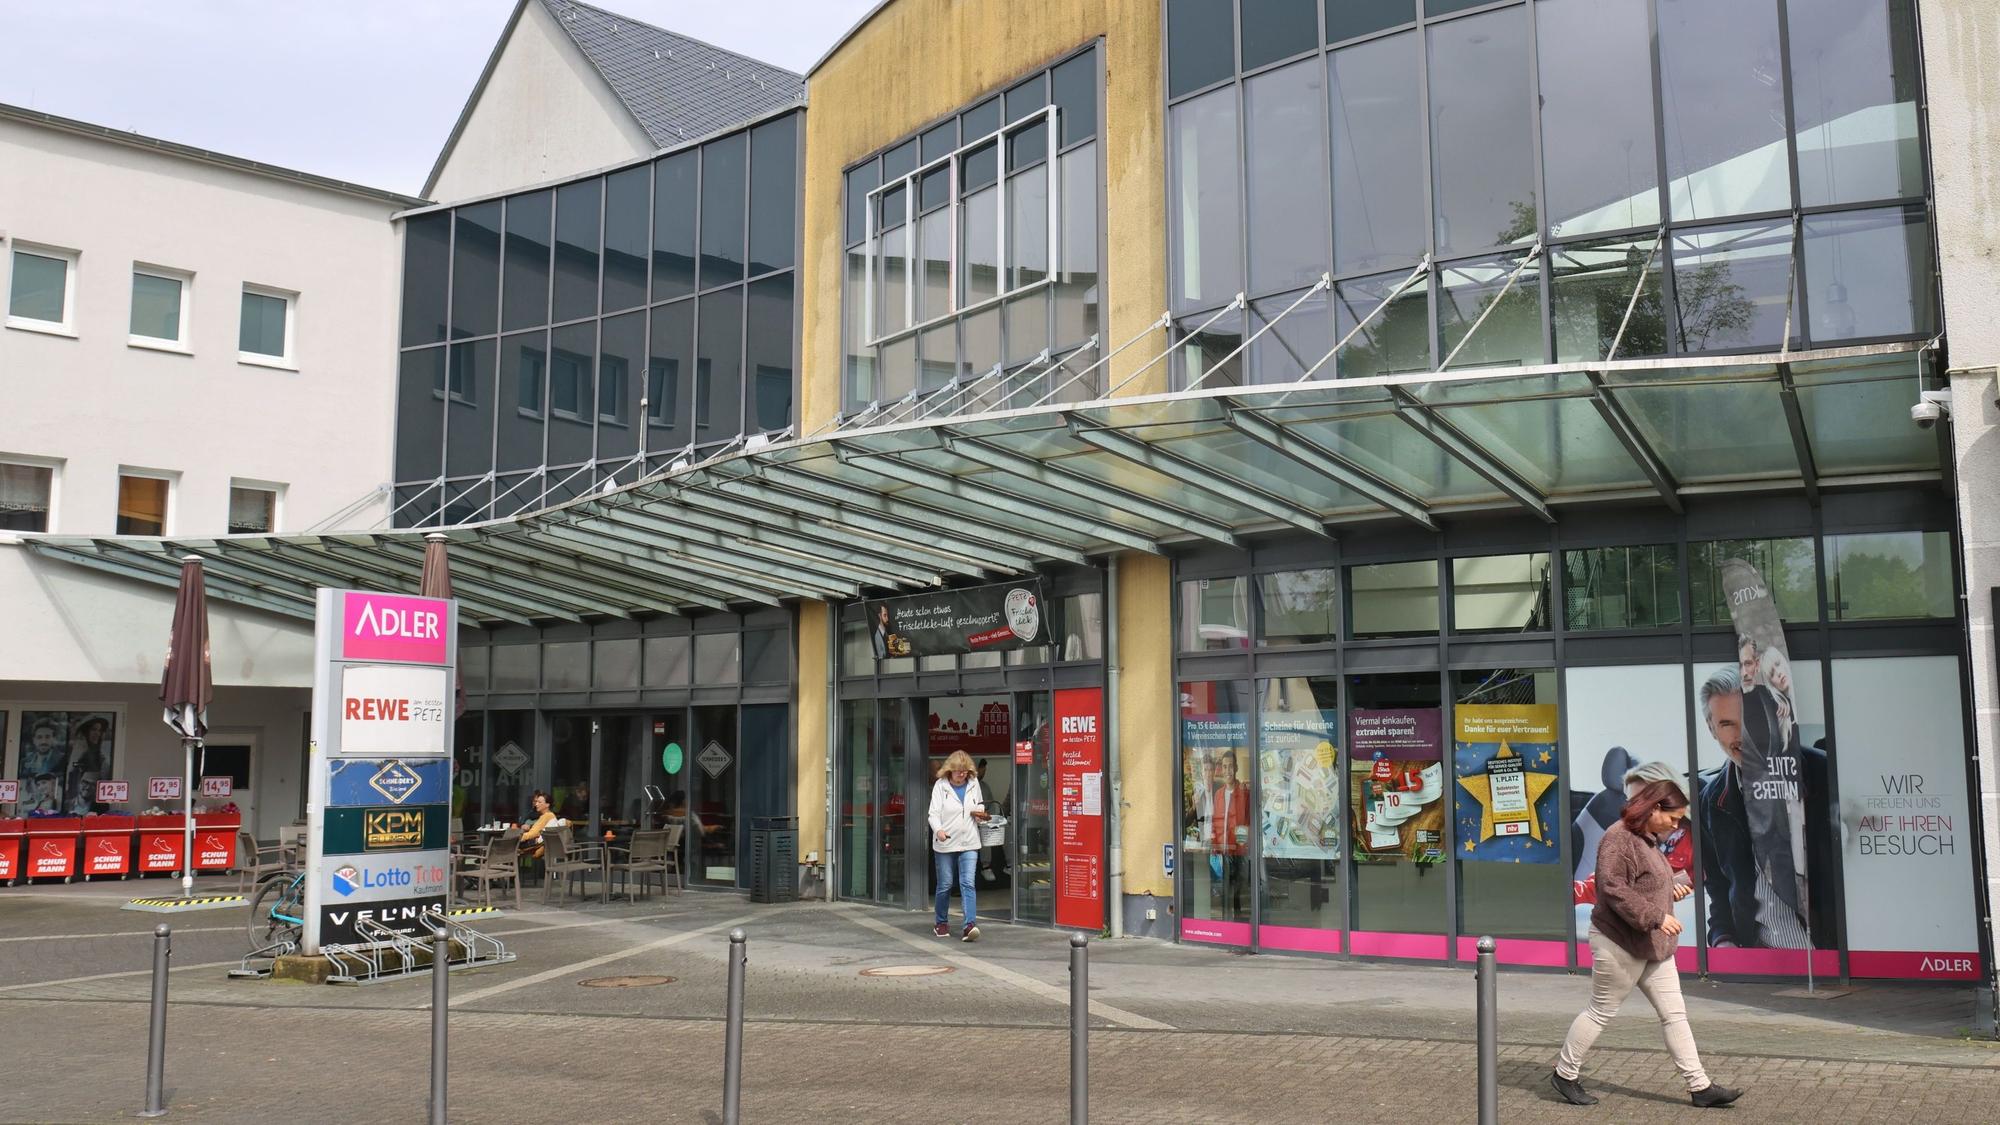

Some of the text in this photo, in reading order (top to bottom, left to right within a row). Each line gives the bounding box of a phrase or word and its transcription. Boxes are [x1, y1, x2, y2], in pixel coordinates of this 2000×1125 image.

[933, 604, 951, 615] etwas
[354, 600, 440, 640] ADLER
[345, 697, 410, 721] REWE
[413, 706, 443, 722] PETZ
[1062, 715, 1096, 733] REWE
[1187, 721, 1196, 730] Pro
[1198, 721, 1204, 730] 15
[1209, 721, 1246, 730] Einkaufswert
[1264, 719, 1334, 731] Scheine für Vereine
[1355, 715, 1416, 726] Viermal einkaufen,
[1355, 726, 1415, 737] extraviel sparen!
[1464, 725, 1549, 734] Danke für euer Vertrauen!
[1264, 734, 1274, 744] ist
[1397, 767, 1424, 792] 15
[1881, 774, 1924, 794] WIR
[100, 784, 126, 799] 12,95
[152, 780, 178, 795] 12,95
[204, 780, 229, 794] 14,95
[1387, 794, 1400, 807] 10
[1867, 797, 1941, 809] FREUEN UNS
[1377, 803, 1384, 814] 7
[368, 811, 422, 834] KPM
[1369, 812, 1375, 823] 3
[1858, 815, 1952, 832] AUF IHREN
[1859, 835, 1955, 856] BESUCH
[37, 858, 67, 866] SCHUH
[364, 867, 411, 888] Lotto
[1920, 956, 1973, 972] ADLER
